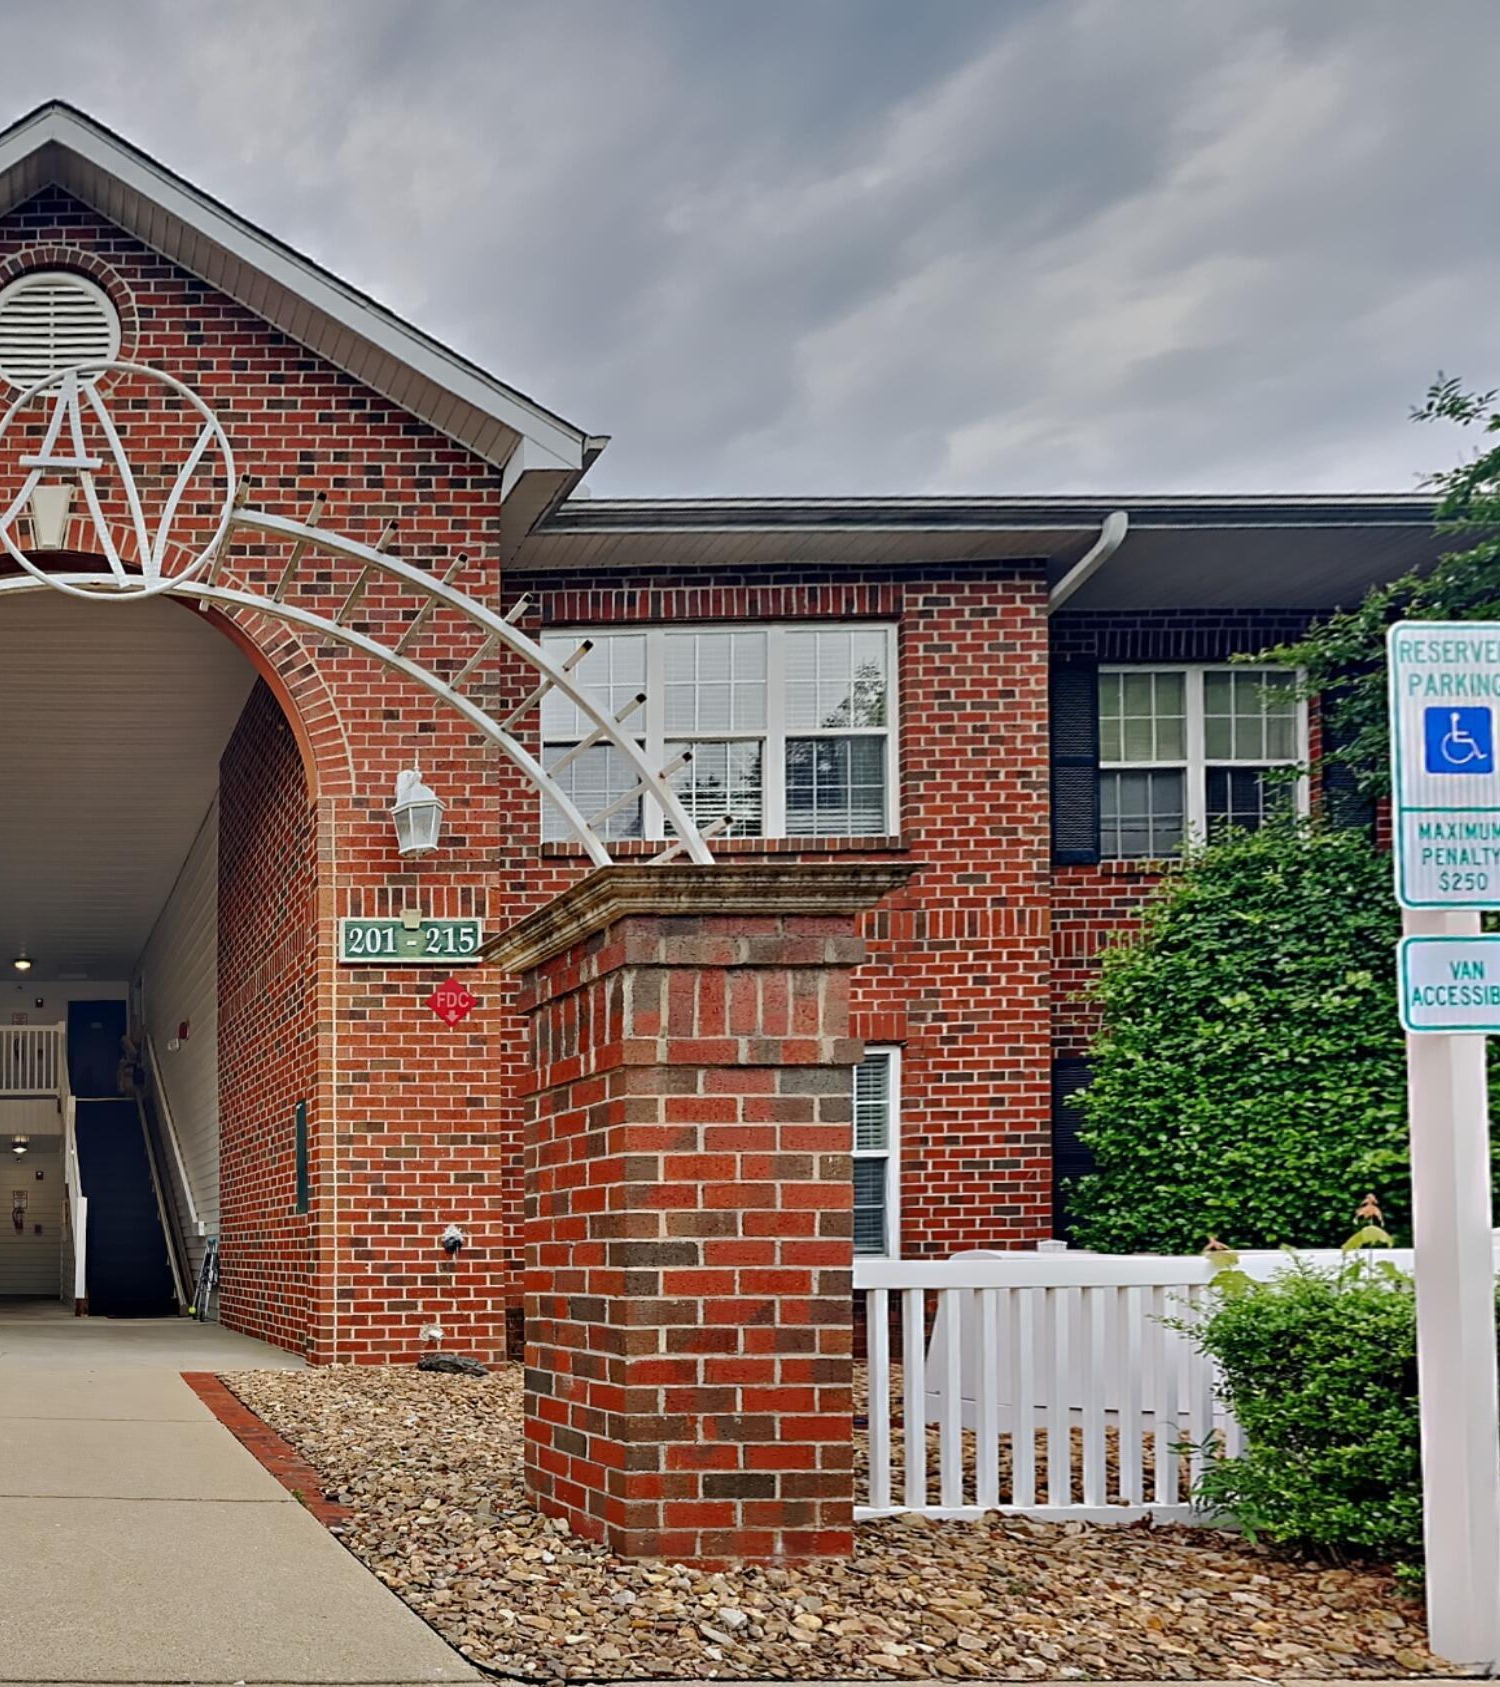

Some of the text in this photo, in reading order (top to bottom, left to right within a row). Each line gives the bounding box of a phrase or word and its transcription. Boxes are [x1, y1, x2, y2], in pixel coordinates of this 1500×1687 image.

[1400, 640, 1500, 664] RESERVE
[1422, 847, 1500, 865] PENALTY
[1438, 871, 1488, 892] $250
[349, 927, 397, 954] 201
[426, 927, 475, 954] 215
[1449, 960, 1485, 981] VAN
[436, 991, 470, 1009] FDC
